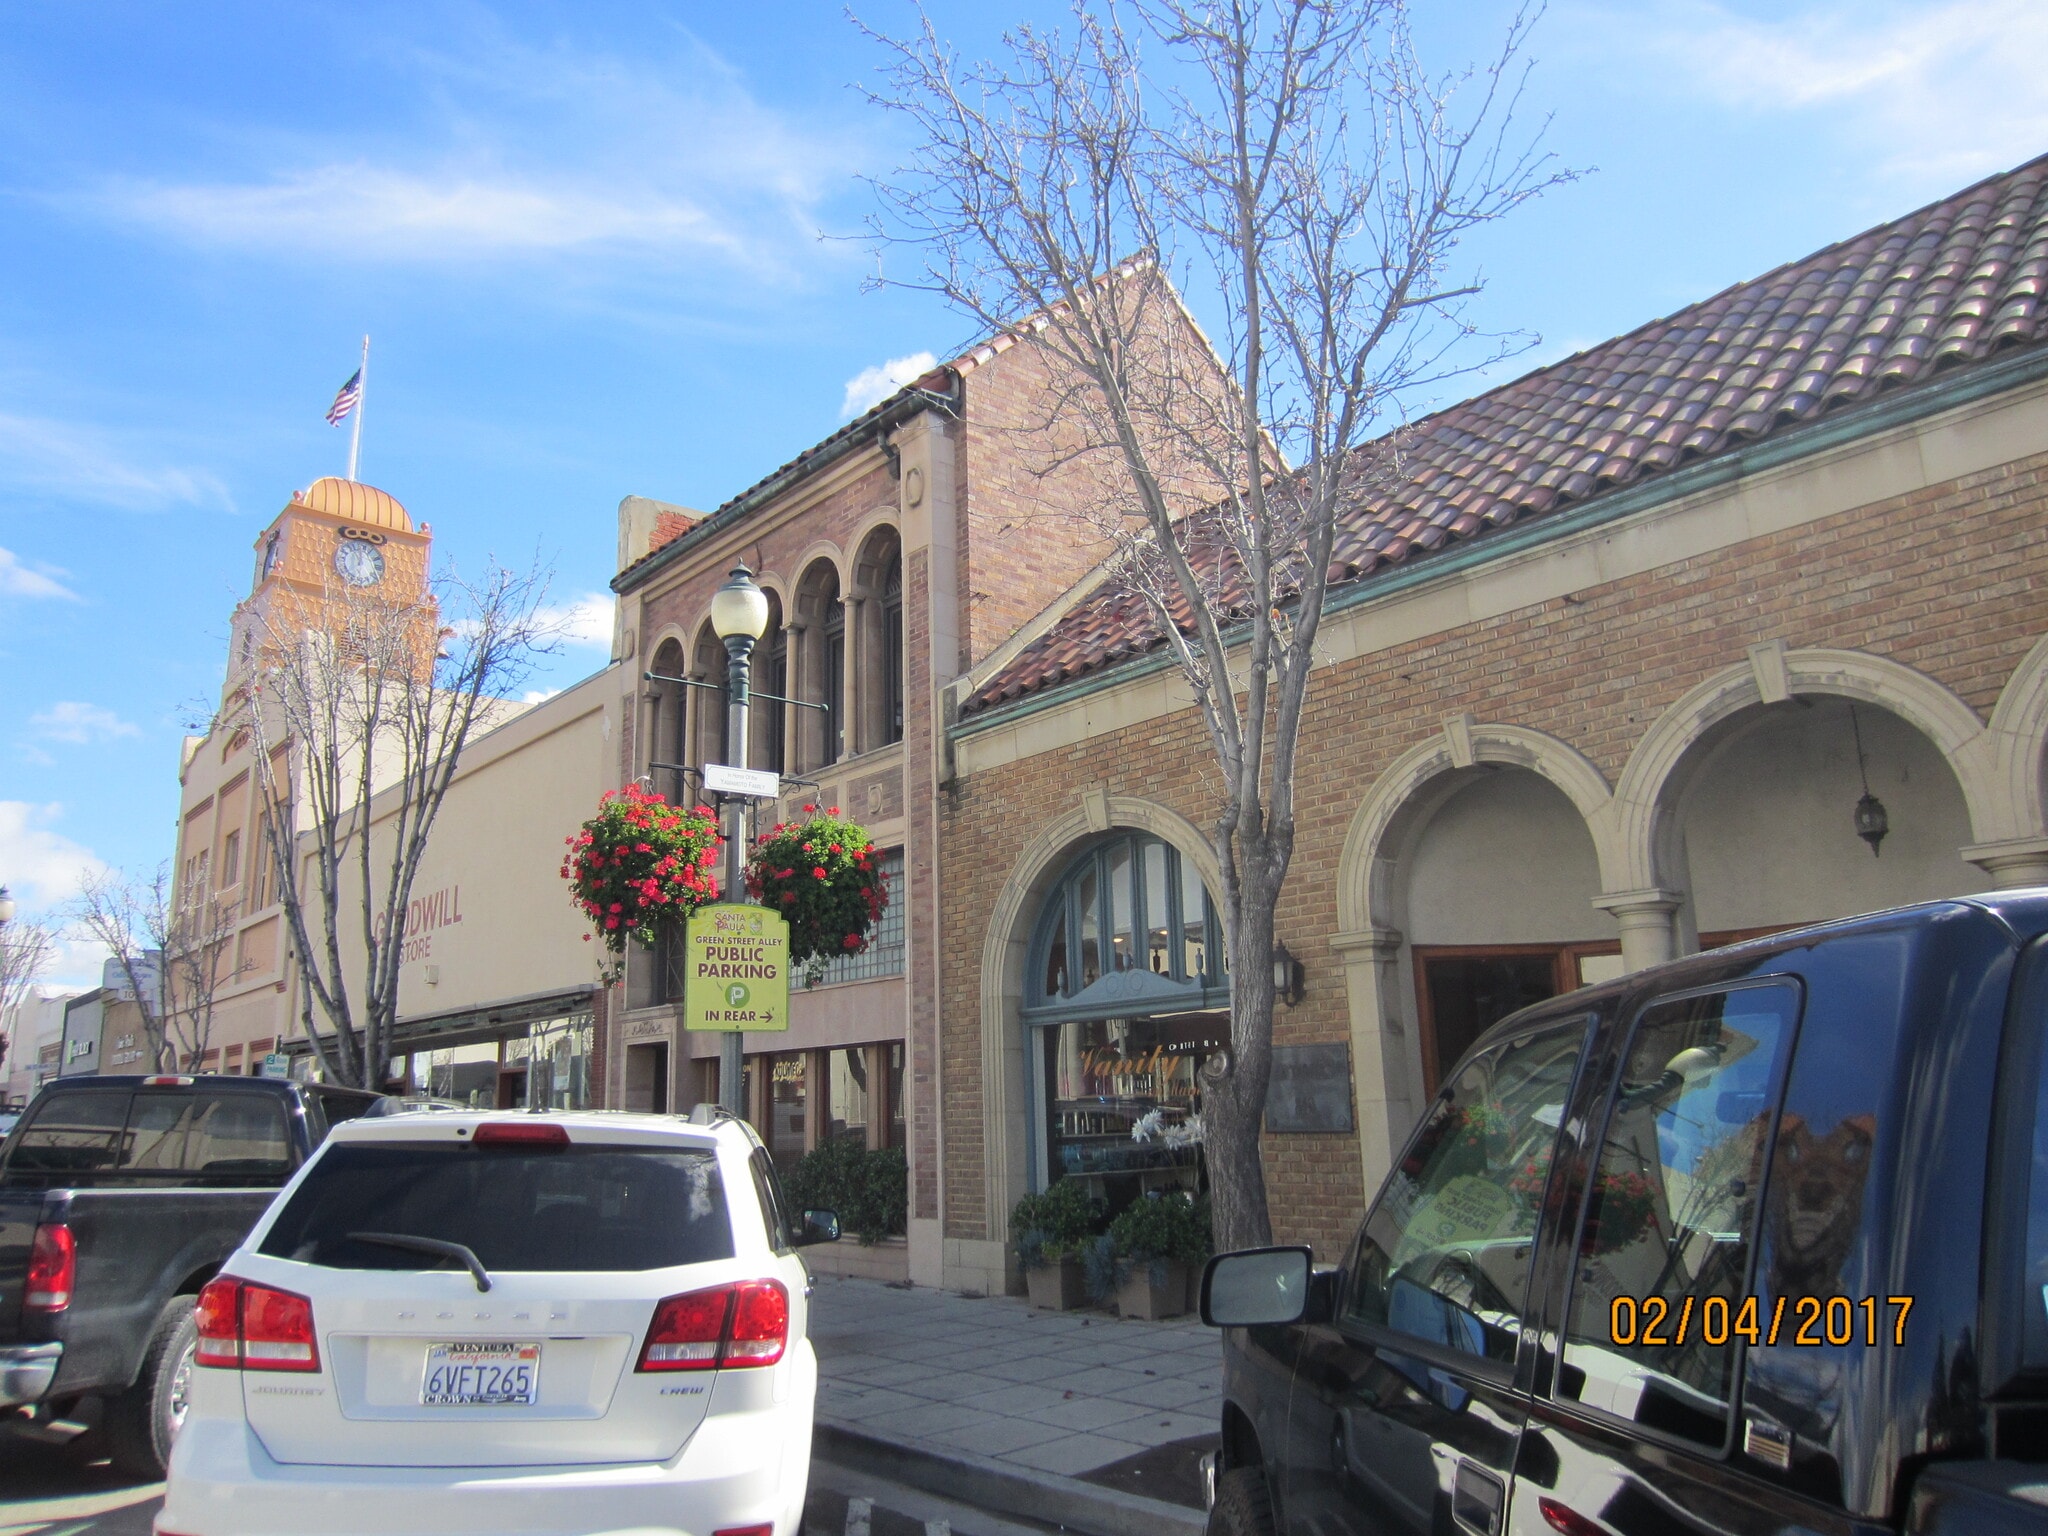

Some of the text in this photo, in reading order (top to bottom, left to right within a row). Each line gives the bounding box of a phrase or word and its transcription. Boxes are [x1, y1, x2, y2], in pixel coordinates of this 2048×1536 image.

[714, 913, 746, 922] SANTA
[715, 920, 746, 933] PAULA
[695, 936, 783, 946] GREEN STREET ALLEY
[705, 946, 764, 962] PUBLIC
[698, 963, 777, 979] PARKING
[705, 1010, 756, 1021] IN REAR
[1080, 1044, 1181, 1084] Vanity
[455, 1343, 514, 1353] VENTURA
[428, 1365, 530, 1395] 6VFT265
[660, 1386, 704, 1395] CREW
[425, 1394, 473, 1405] CROWN
